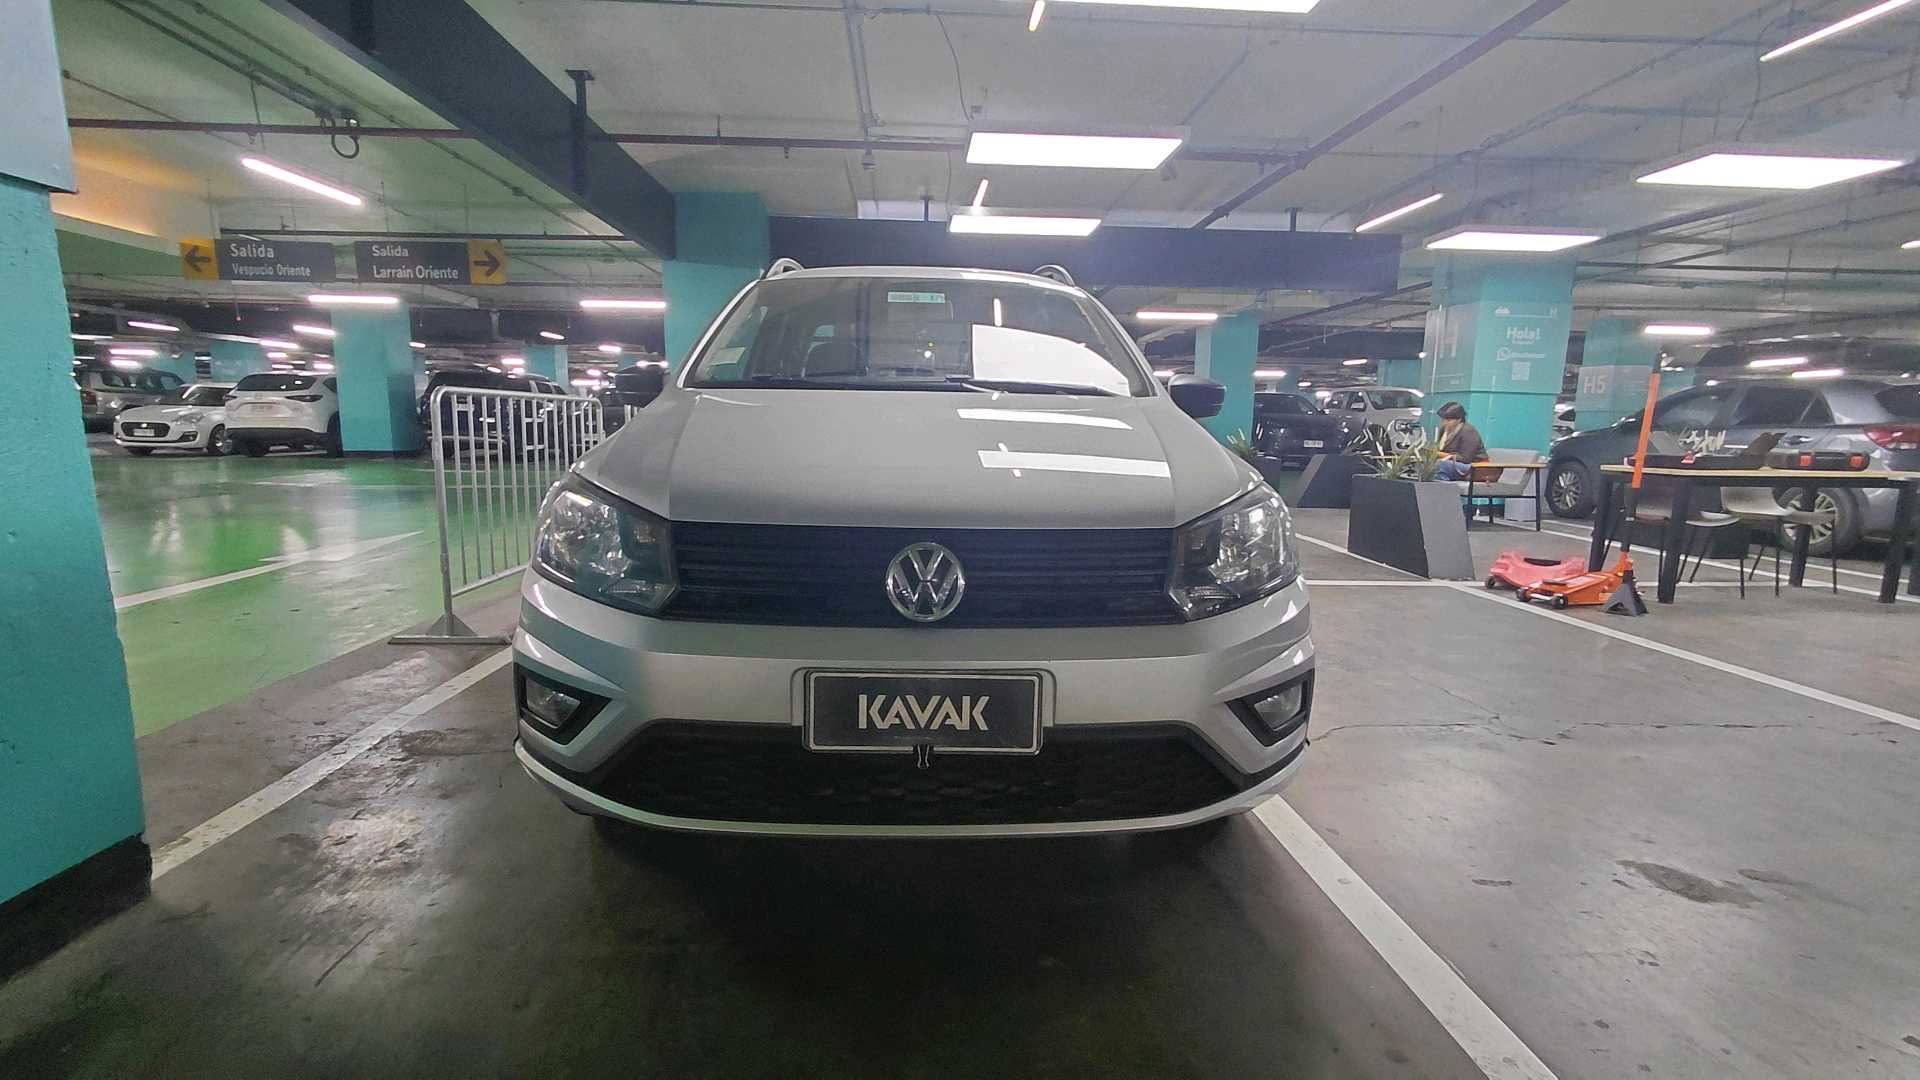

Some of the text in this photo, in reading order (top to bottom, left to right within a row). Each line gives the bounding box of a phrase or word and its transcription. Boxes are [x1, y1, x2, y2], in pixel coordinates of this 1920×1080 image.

[230, 243, 275, 258] Salida
[371, 244, 409, 257] Salida
[276, 263, 311, 276] Oriente
[415, 265, 459, 279] Oriente
[1506, 326, 1541, 340] Hola!
[1583, 374, 1606, 394] H5
[858, 694, 990, 730] KAVAK
